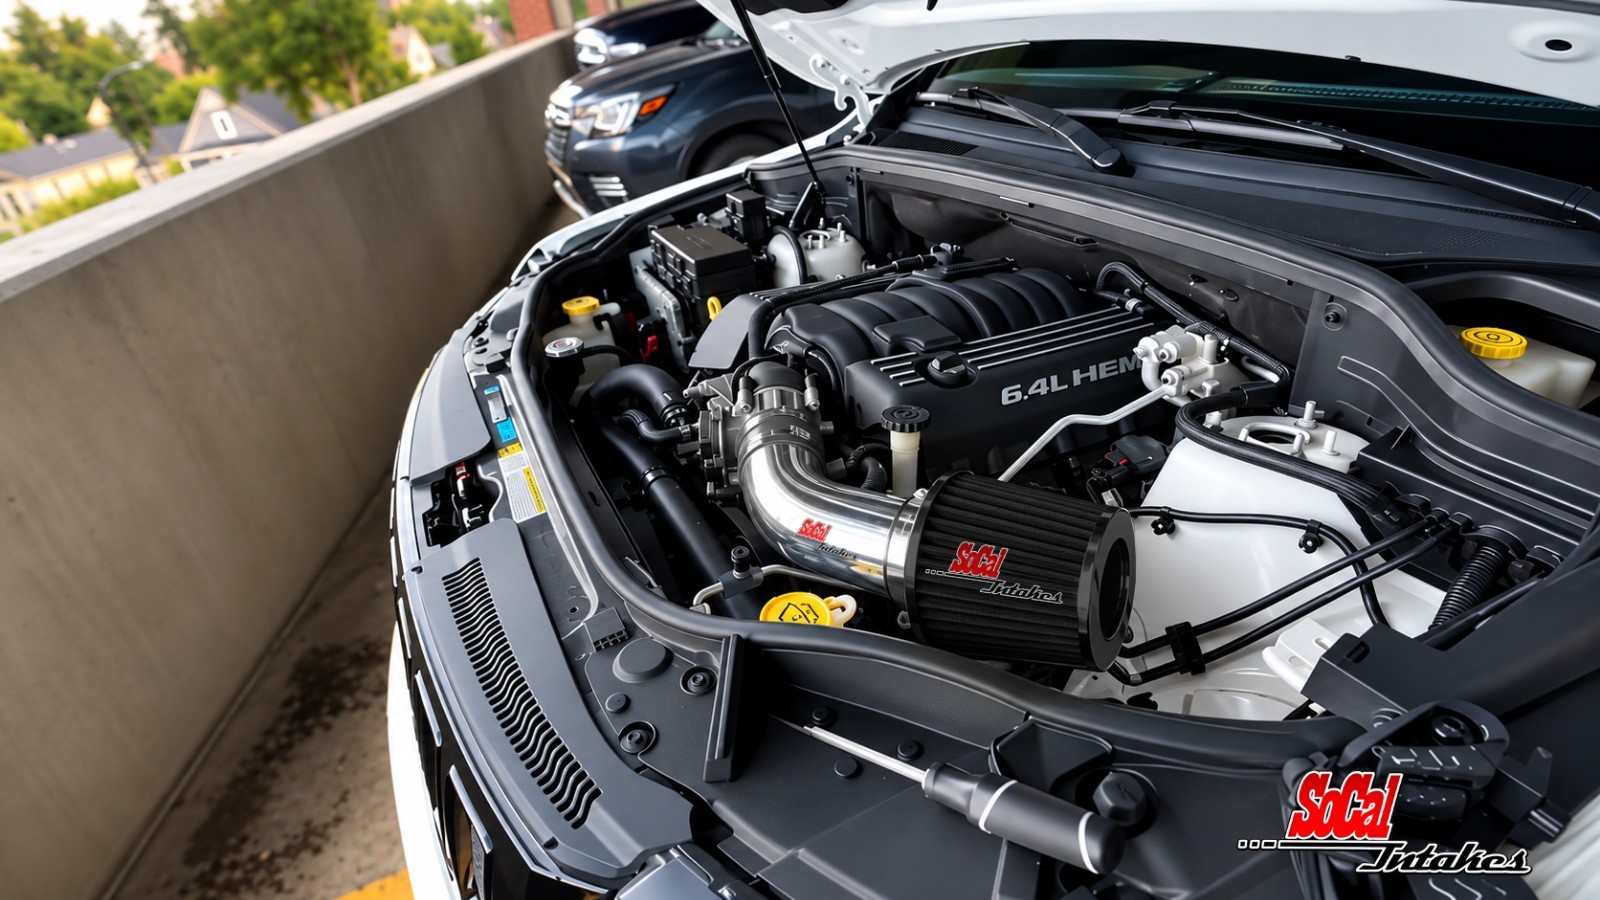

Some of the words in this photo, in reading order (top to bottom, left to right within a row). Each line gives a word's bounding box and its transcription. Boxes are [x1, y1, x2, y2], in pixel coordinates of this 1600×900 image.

[1001, 375, 1068, 406] 6.4L
[1072, 354, 1143, 387] HEM
[948, 540, 1009, 579] SoCal
[980, 580, 1063, 605] Intakes
